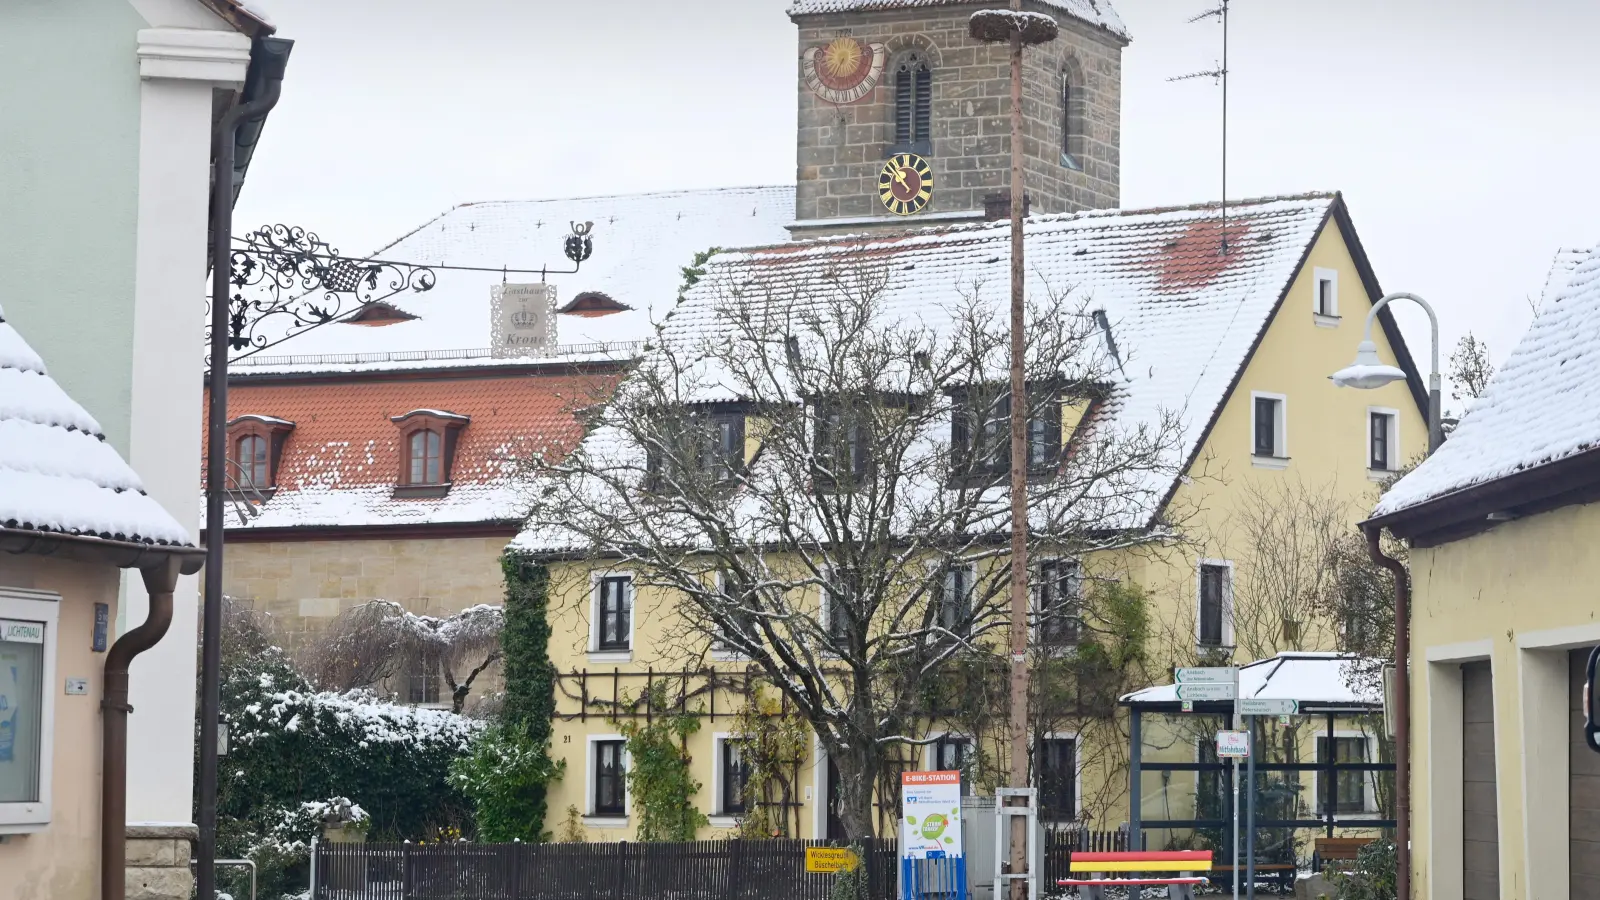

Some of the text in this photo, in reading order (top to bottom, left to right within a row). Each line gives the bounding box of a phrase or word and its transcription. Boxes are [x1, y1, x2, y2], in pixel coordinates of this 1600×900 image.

[506, 333, 545, 345] Krone
[8, 624, 40, 639] LICHTENAU
[563, 734, 571, 744] 21
[905, 774, 956, 782] E-BIKE-STATION
